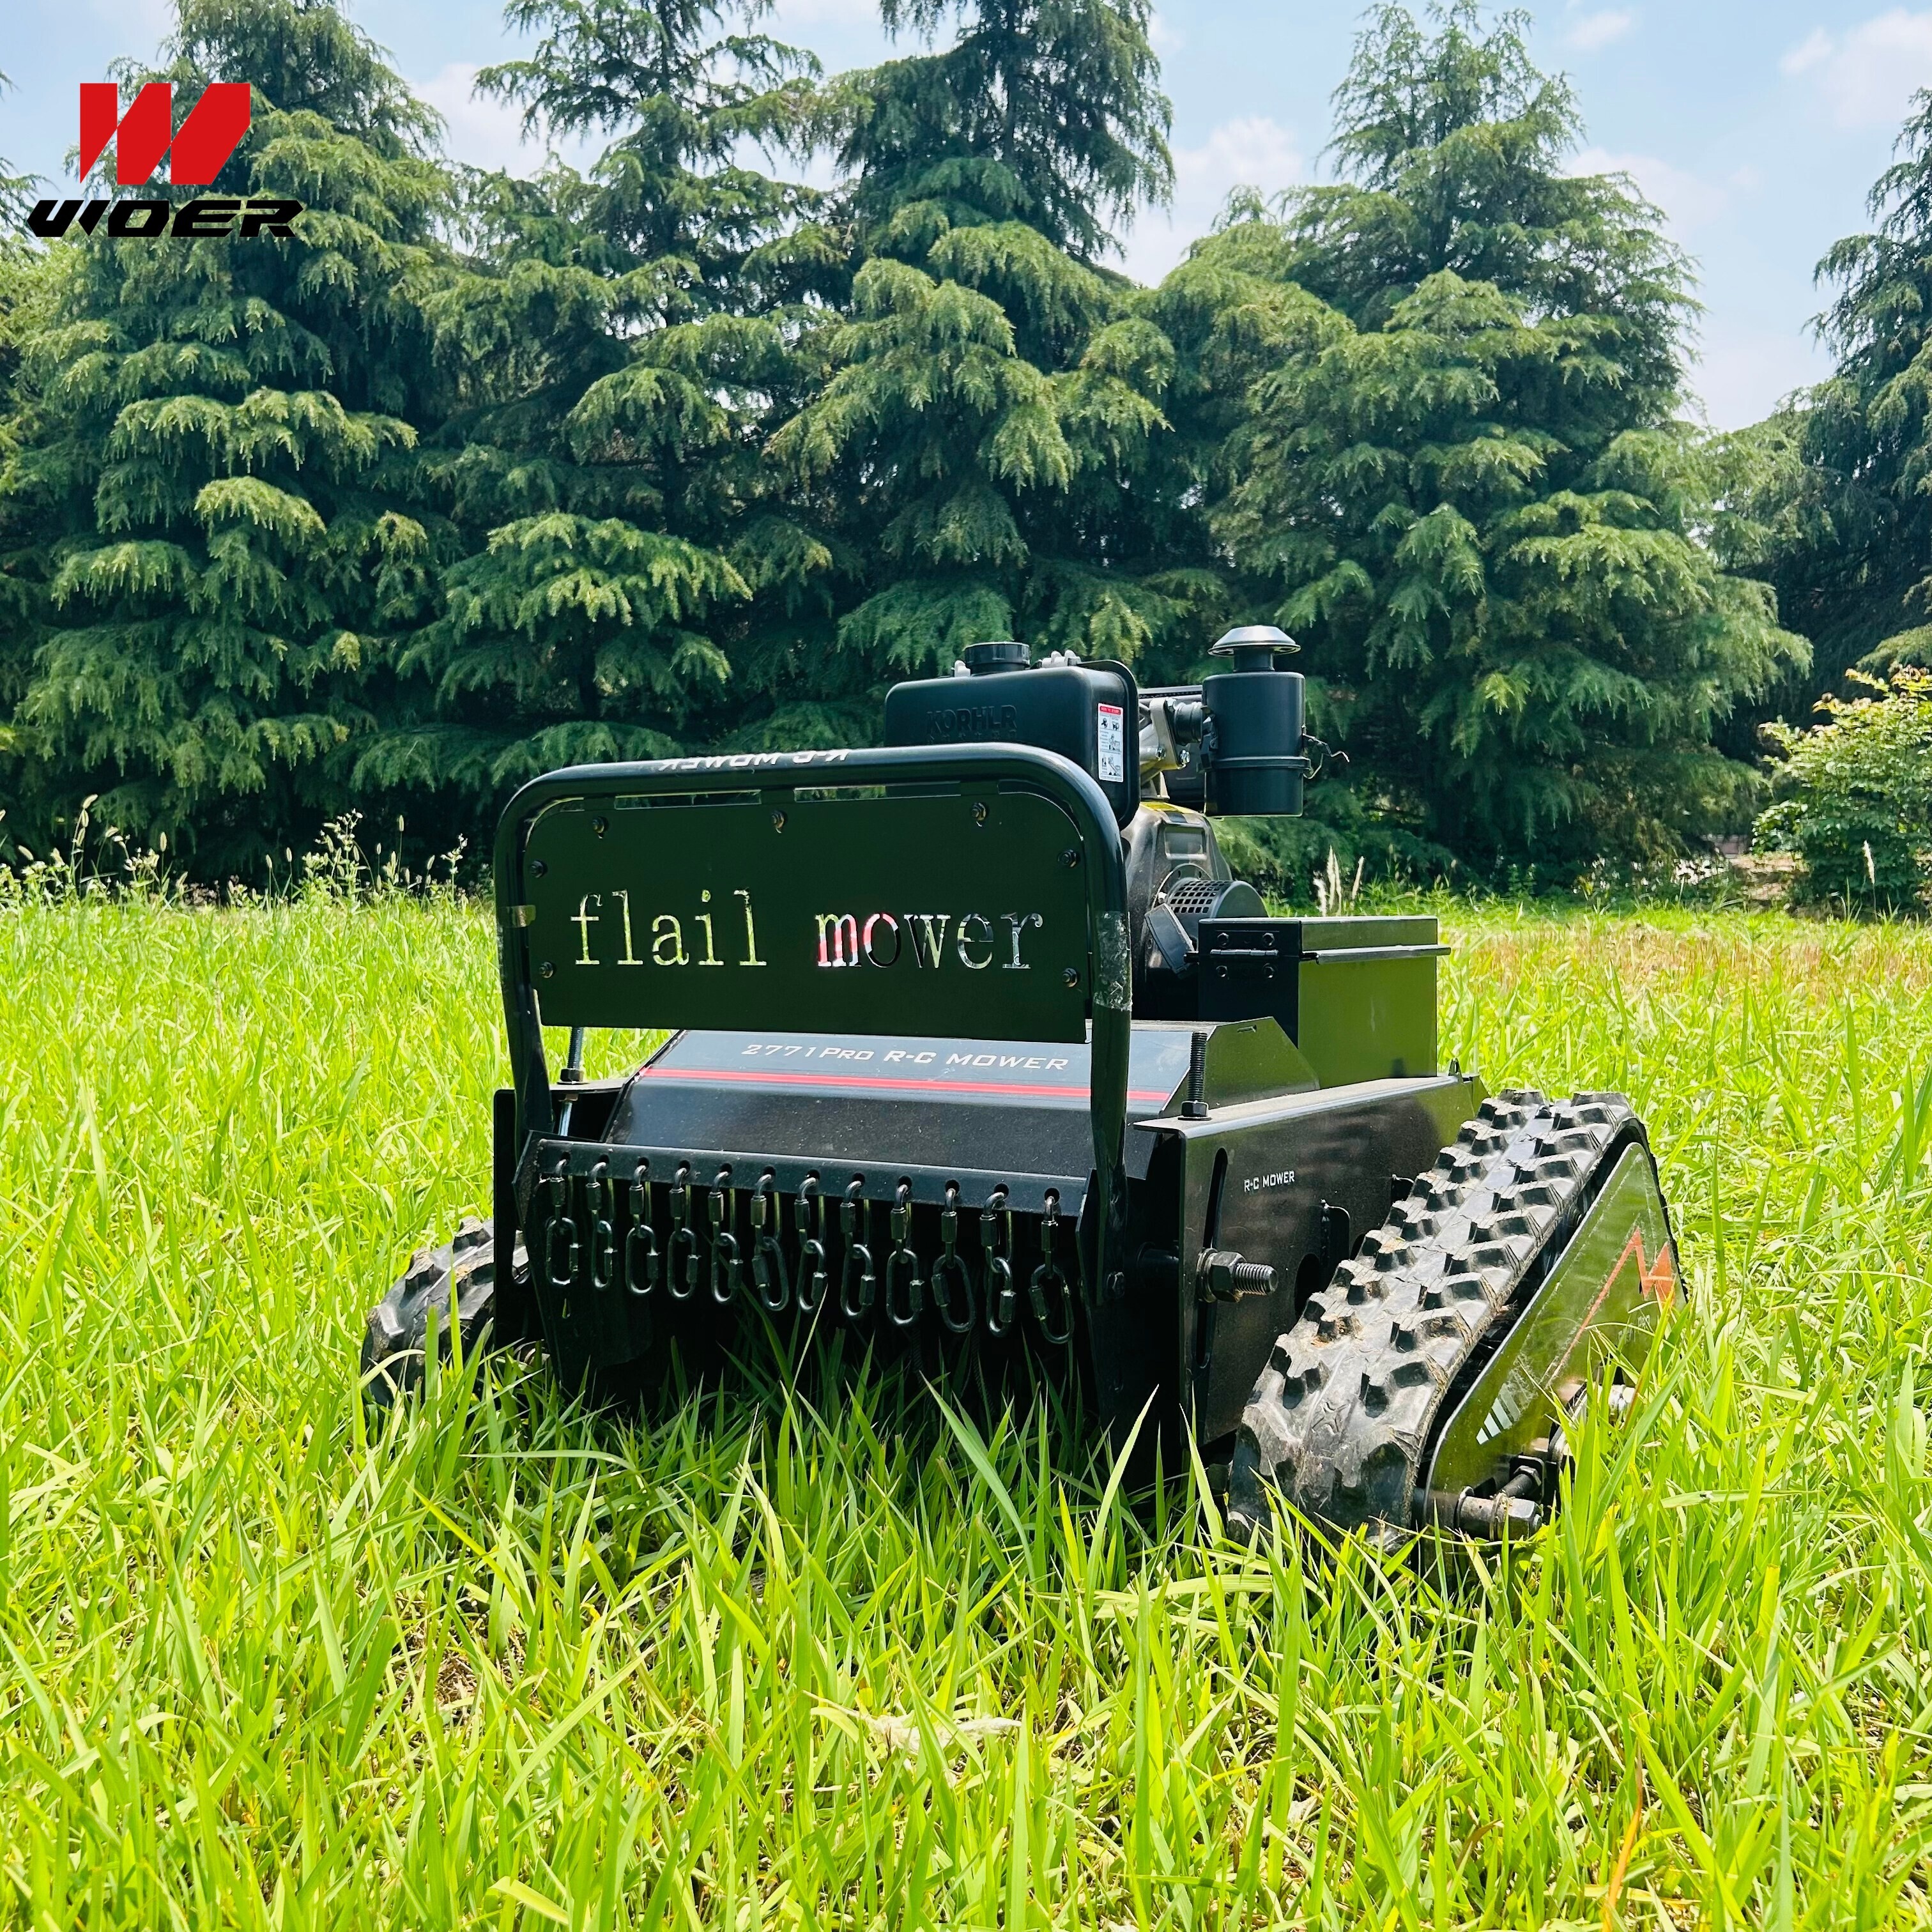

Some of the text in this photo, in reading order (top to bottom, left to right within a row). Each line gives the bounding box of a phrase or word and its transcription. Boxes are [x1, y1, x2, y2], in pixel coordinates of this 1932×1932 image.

[570, 889, 1043, 969] flail mower
[883, 1050, 937, 1064] R-C
[946, 1052, 1069, 1071] MOWER
[1244, 1170, 1295, 1192] R-C MOWER
